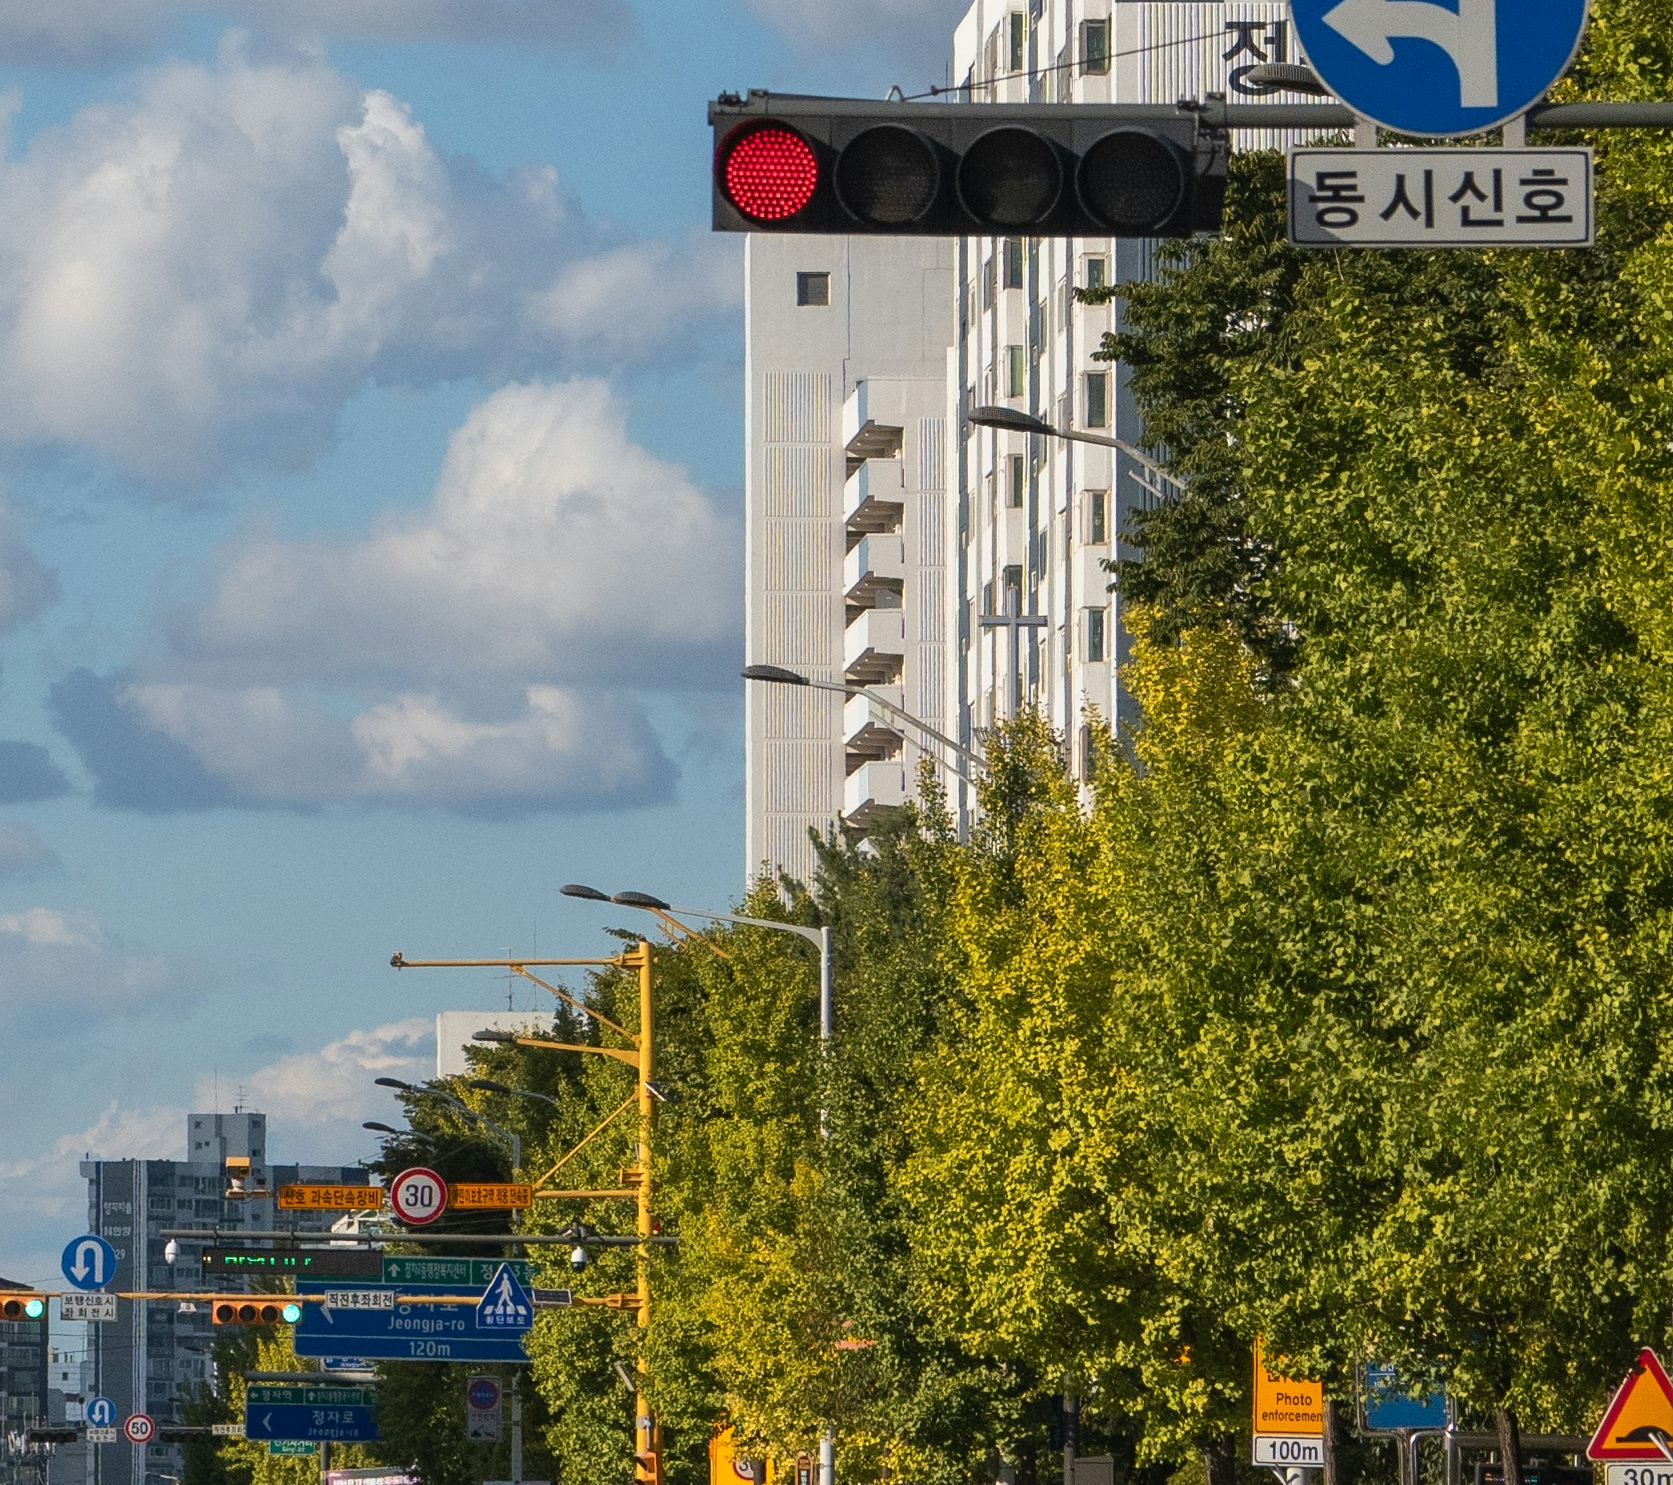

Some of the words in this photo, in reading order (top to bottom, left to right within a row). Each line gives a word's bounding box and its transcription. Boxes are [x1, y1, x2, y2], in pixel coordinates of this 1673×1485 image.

[1309, 168, 1574, 228] 동시신호
[284, 1188, 306, 1205] 신호
[310, 1189, 379, 1206] 과속단속장비
[405, 1184, 433, 1208] 30
[64, 1296, 114, 1306] 보행신호시
[328, 1292, 394, 1309] 직진후좌회전
[64, 1307, 114, 1318] 좌회전시
[388, 1316, 465, 1332] Jeongja-ro
[485, 1316, 526, 1325] 횡단보도
[410, 1341, 451, 1356] 120m
[261, 1389, 293, 1402] 정자역
[1276, 1392, 1313, 1406] Photo
[312, 1409, 355, 1426] 정자로
[1261, 1411, 1323, 1422] enforcemen
[131, 1421, 148, 1435] 50
[1269, 1440, 1319, 1461] 100m
